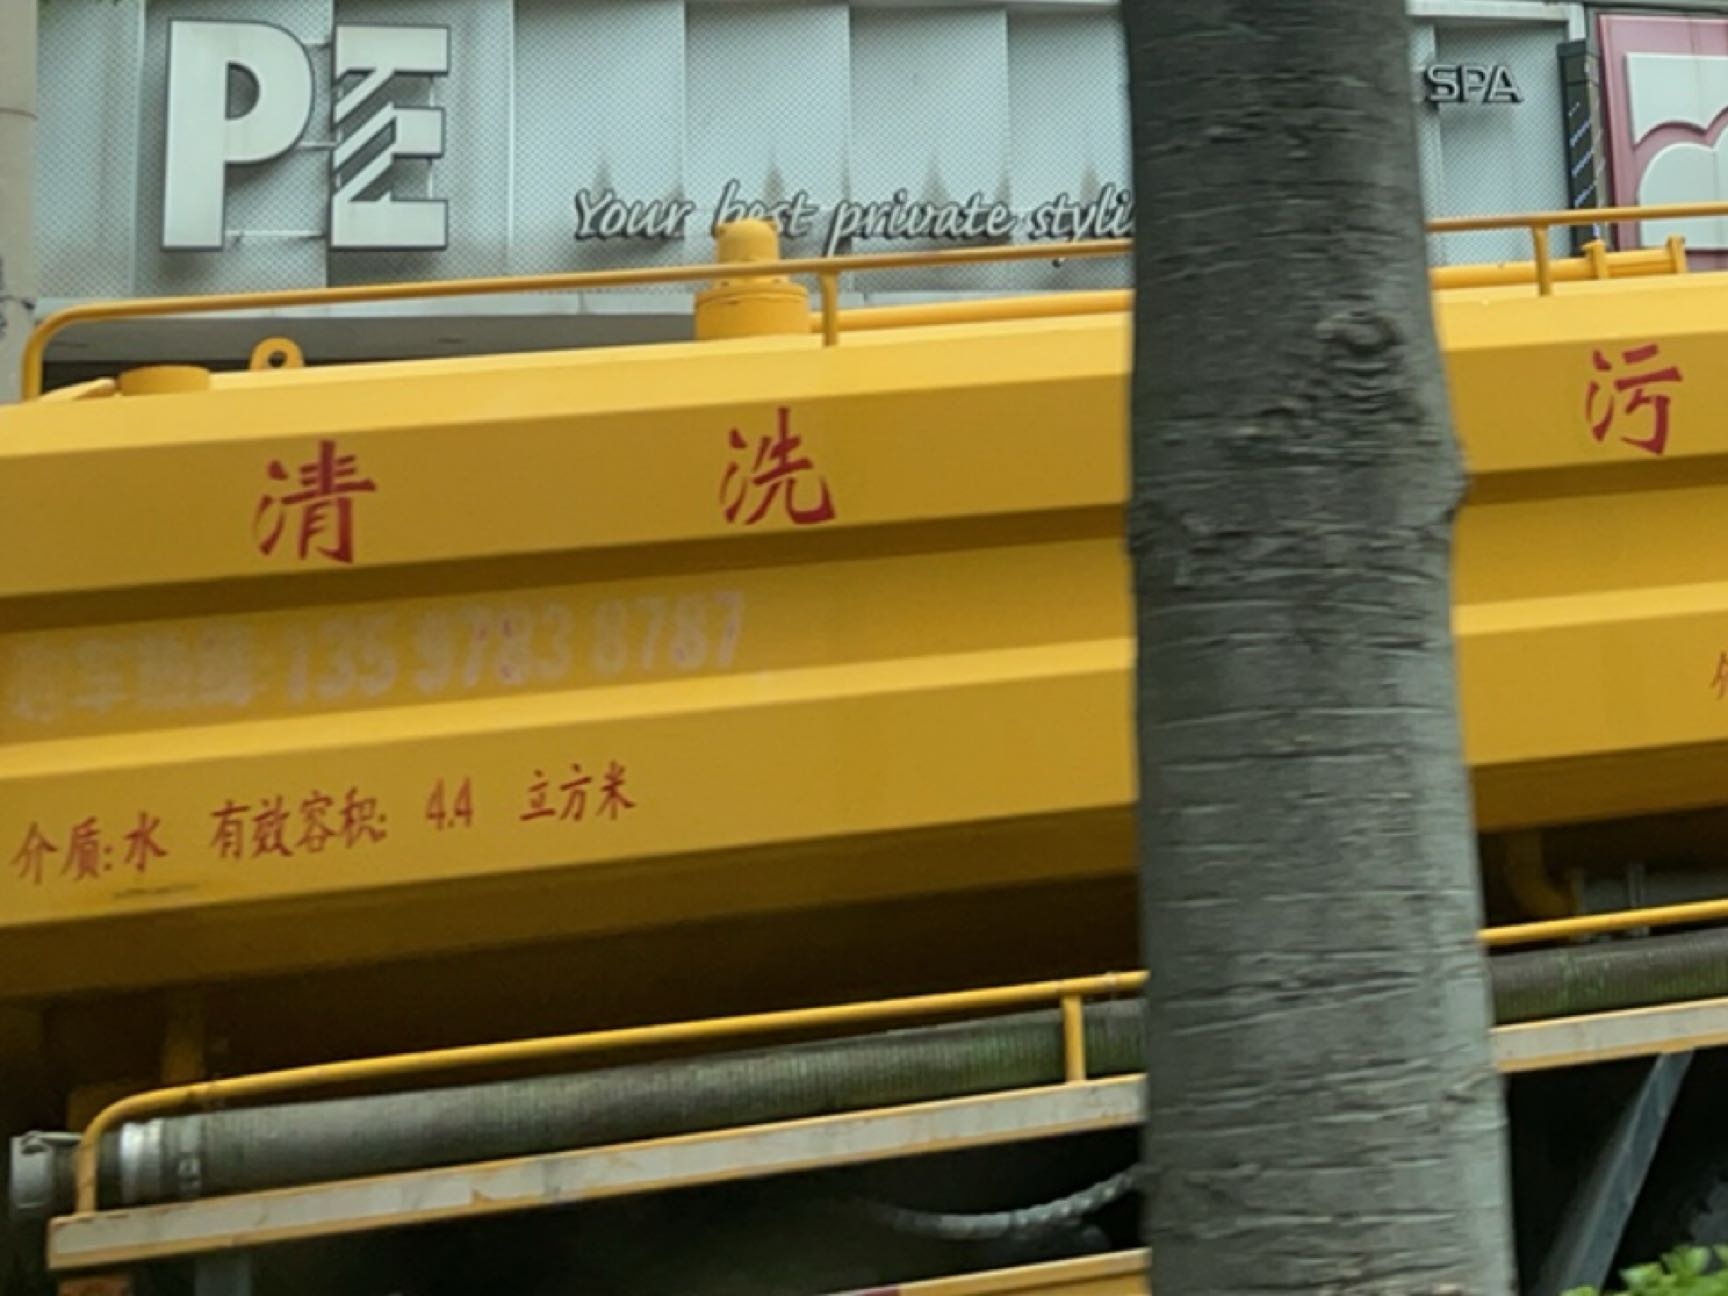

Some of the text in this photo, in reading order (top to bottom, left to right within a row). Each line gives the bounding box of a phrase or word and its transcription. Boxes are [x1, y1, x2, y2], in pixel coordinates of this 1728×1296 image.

[1424, 64, 1523, 103] SPA
[575, 186, 694, 240] Your
[822, 188, 1017, 258] private
[10, 811, 168, 885] 介质:水
[425, 776, 474, 830] 4.4
[520, 760, 637, 822] 立方米
